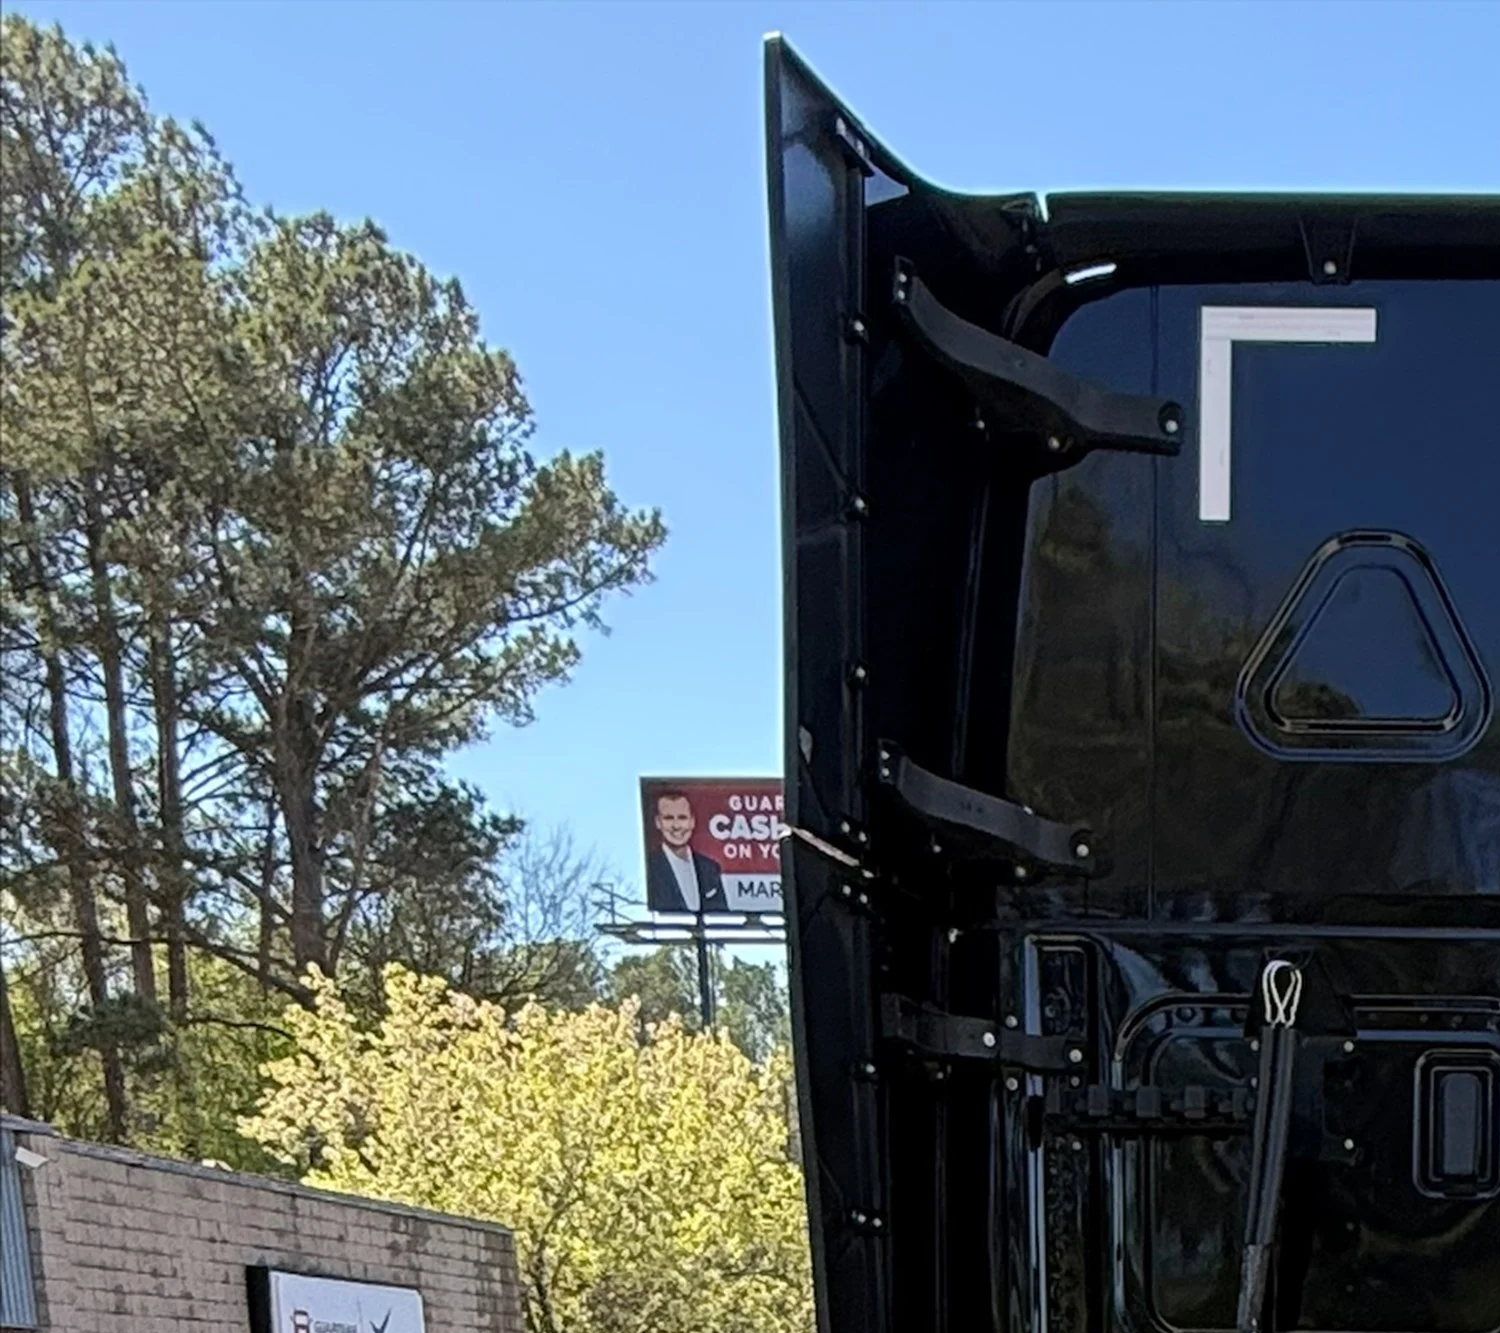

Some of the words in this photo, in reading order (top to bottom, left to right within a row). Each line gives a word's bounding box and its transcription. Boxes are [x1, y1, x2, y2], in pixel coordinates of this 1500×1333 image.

[729, 795, 784, 811] GUAR
[724, 844, 751, 859] ON
[738, 881, 783, 898] MAR
